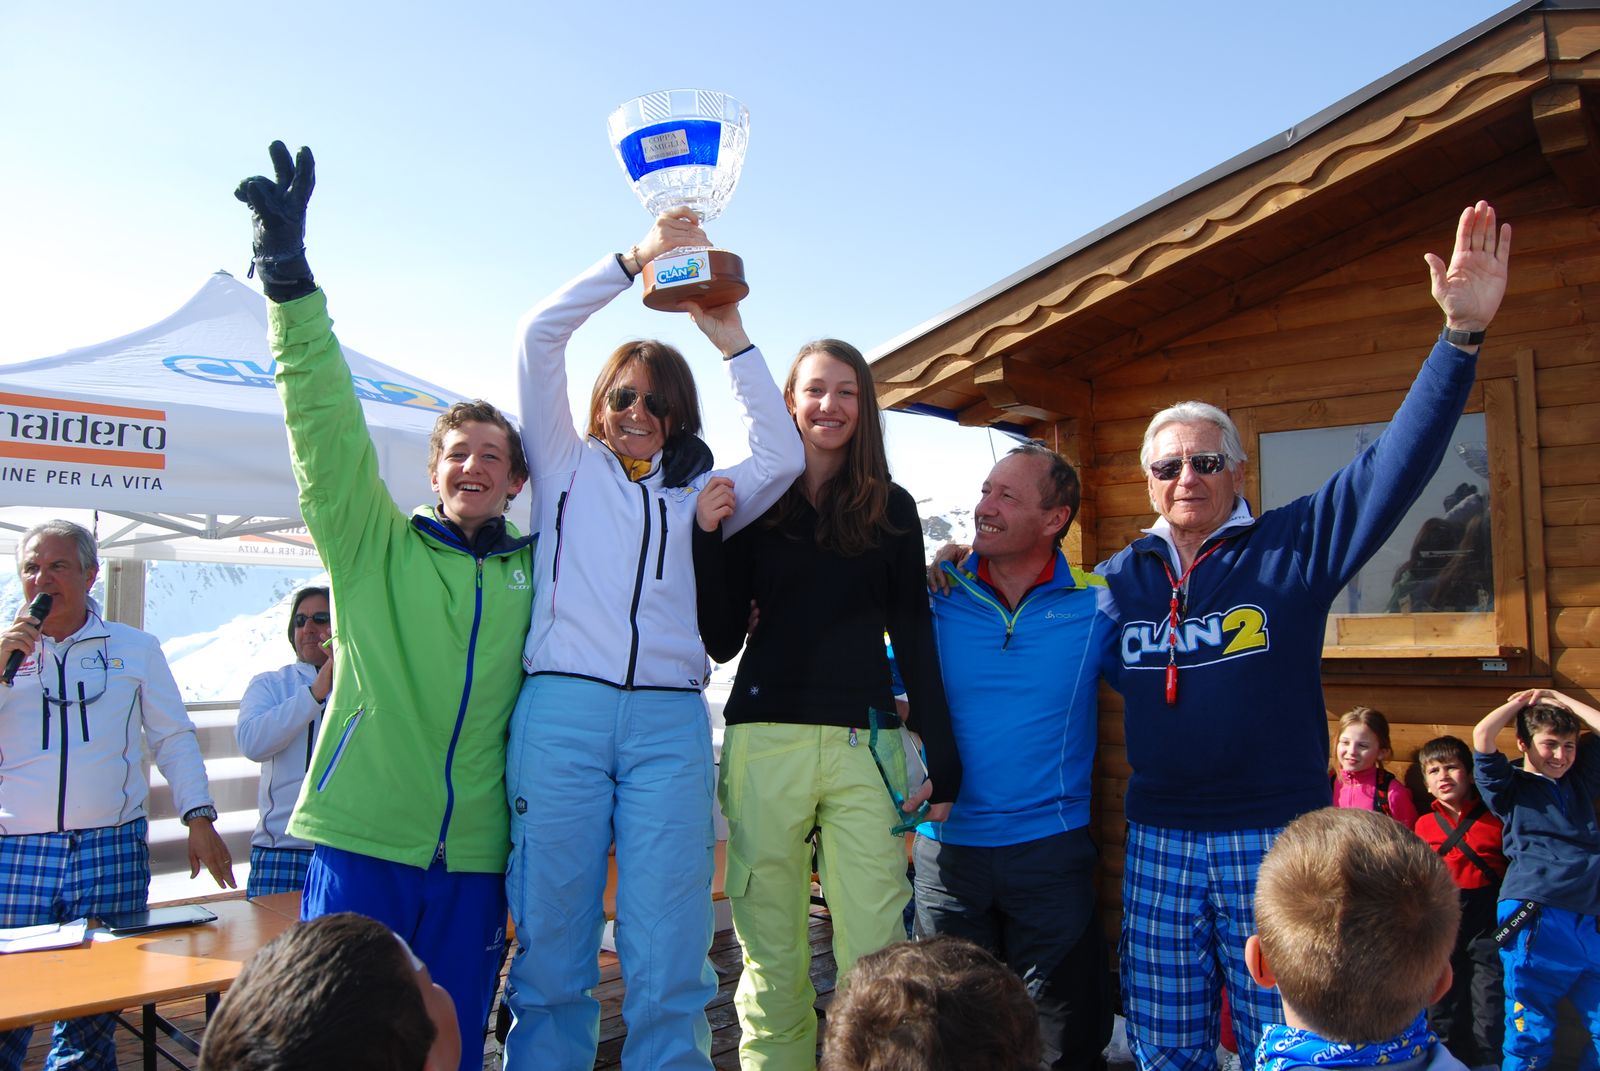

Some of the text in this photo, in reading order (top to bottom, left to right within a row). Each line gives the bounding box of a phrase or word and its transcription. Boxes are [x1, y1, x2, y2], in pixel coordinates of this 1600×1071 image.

[648, 132, 677, 143] COPPA
[644, 139, 686, 153] FAMIGLIA
[46, 469, 82, 486] PER
[91, 473, 113, 488] LA
[123, 475, 163, 491] VITA
